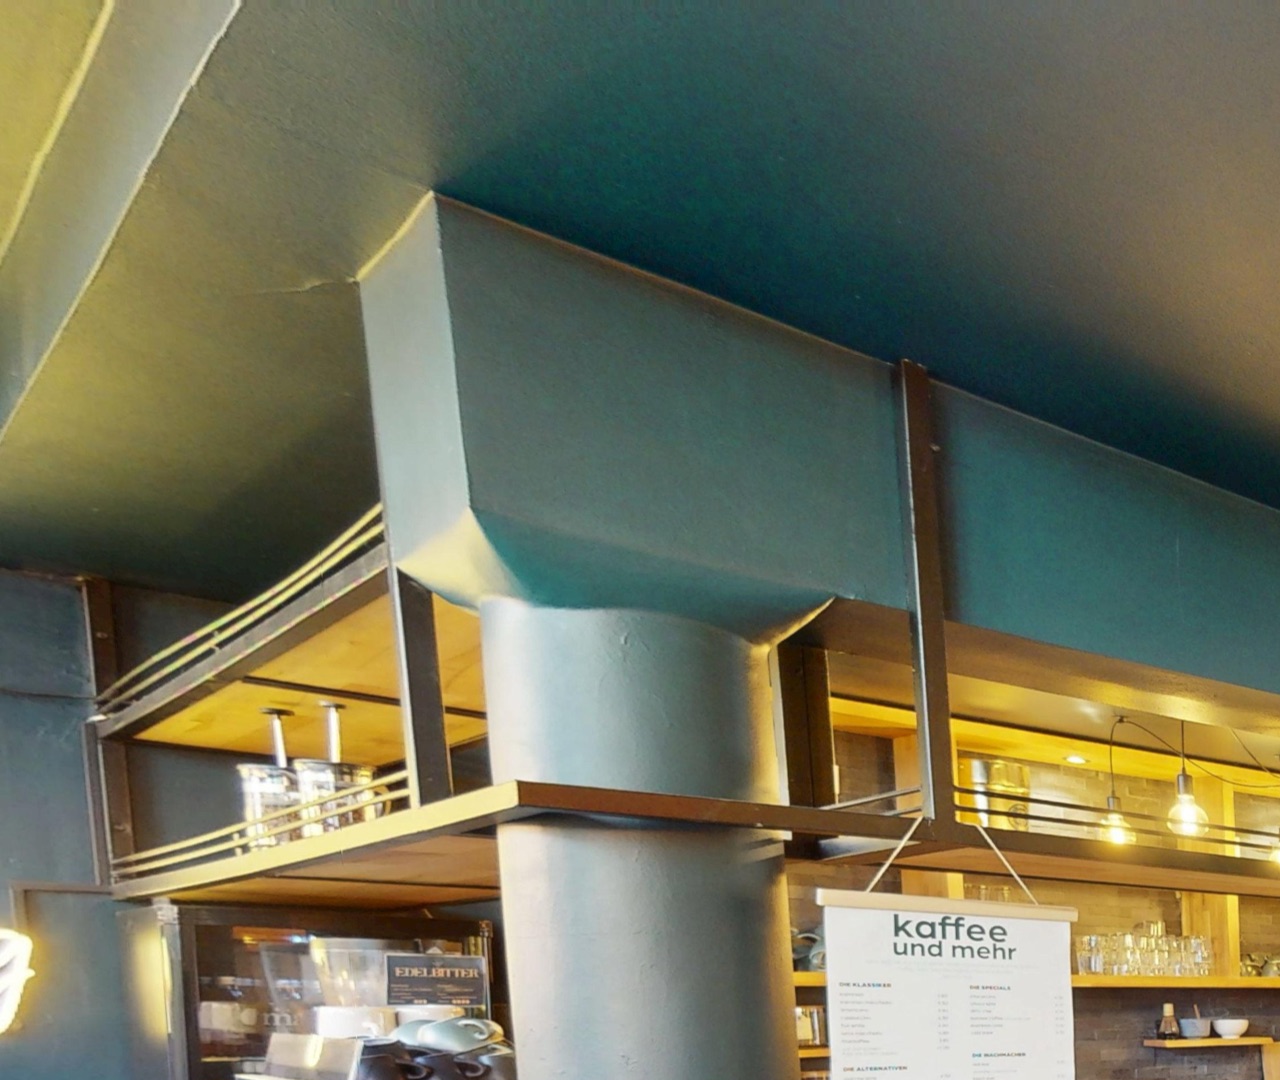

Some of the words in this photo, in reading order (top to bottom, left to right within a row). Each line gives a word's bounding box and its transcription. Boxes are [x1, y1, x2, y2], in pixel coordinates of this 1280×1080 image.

[893, 913, 1008, 943] kaffee
[893, 940, 943, 957] und
[952, 943, 1017, 960] mehr
[394, 967, 479, 978] EDELBITTER
